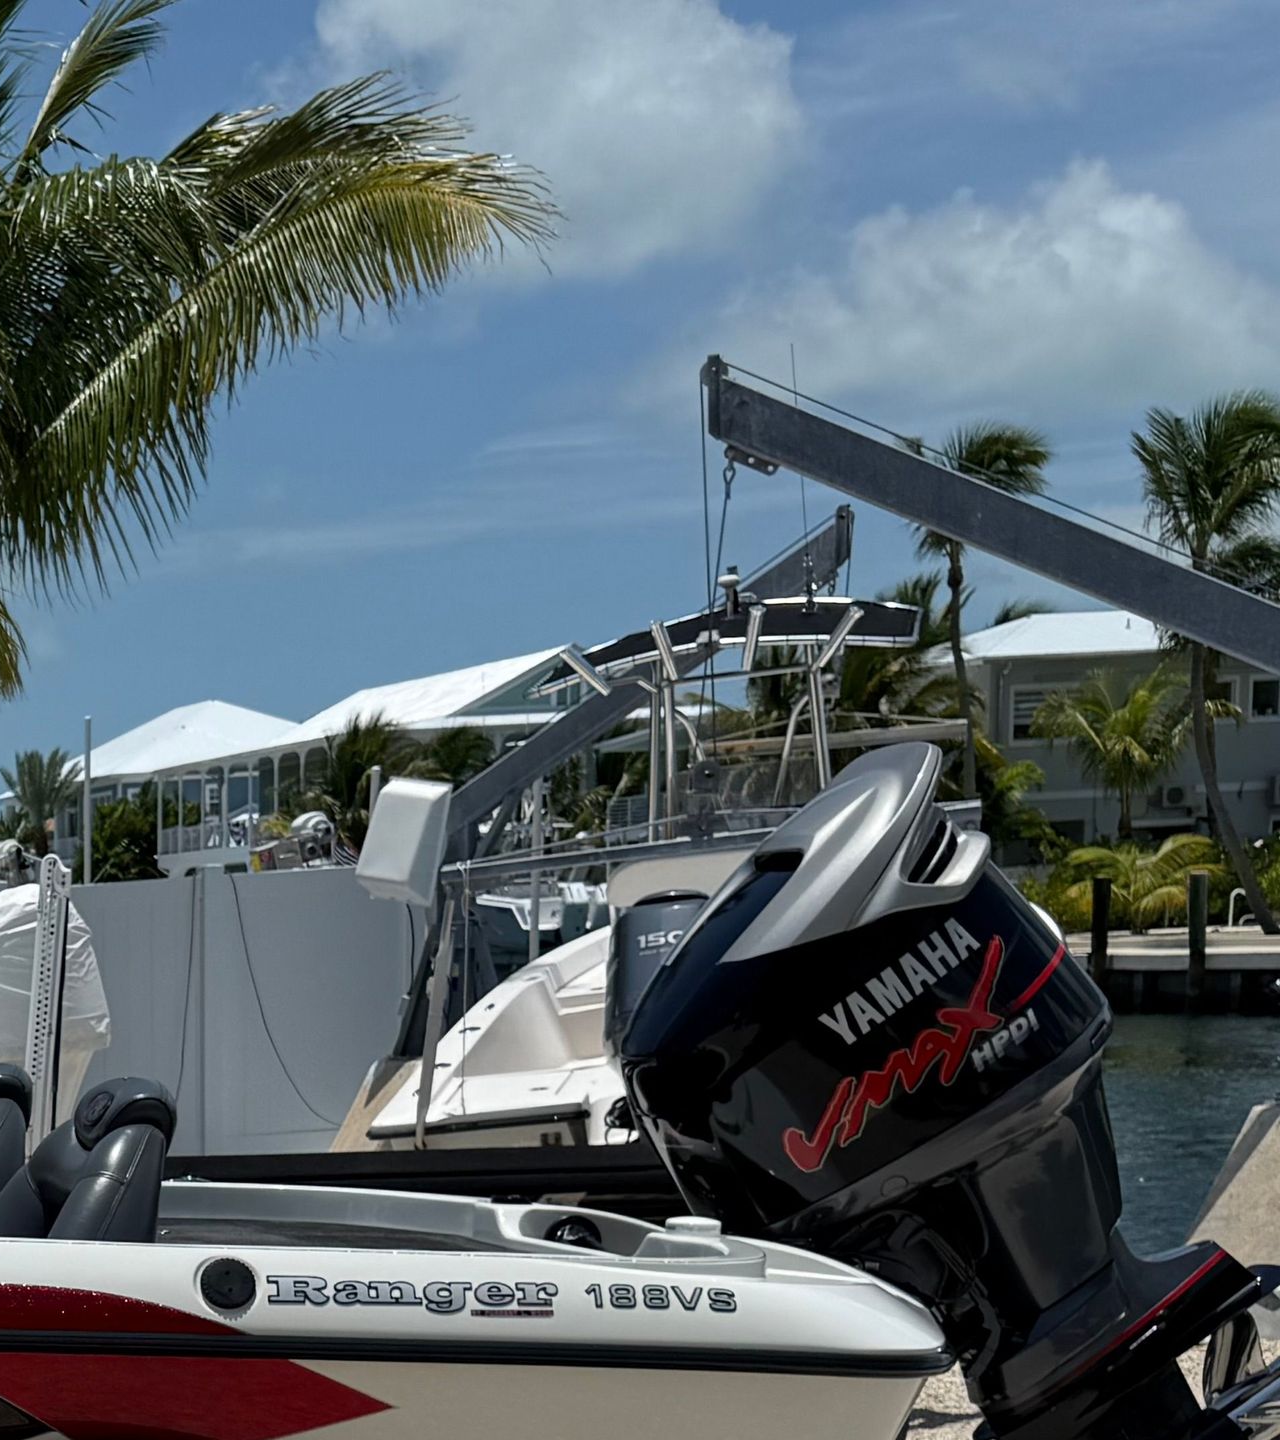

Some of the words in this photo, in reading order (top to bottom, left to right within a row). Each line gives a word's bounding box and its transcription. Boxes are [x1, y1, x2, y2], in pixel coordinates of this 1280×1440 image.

[817, 917, 981, 1046] YAMAHA
[971, 1007, 1040, 1072] HPDI
[266, 1274, 558, 1314] Ranger
[584, 1283, 738, 1312] 188VS
